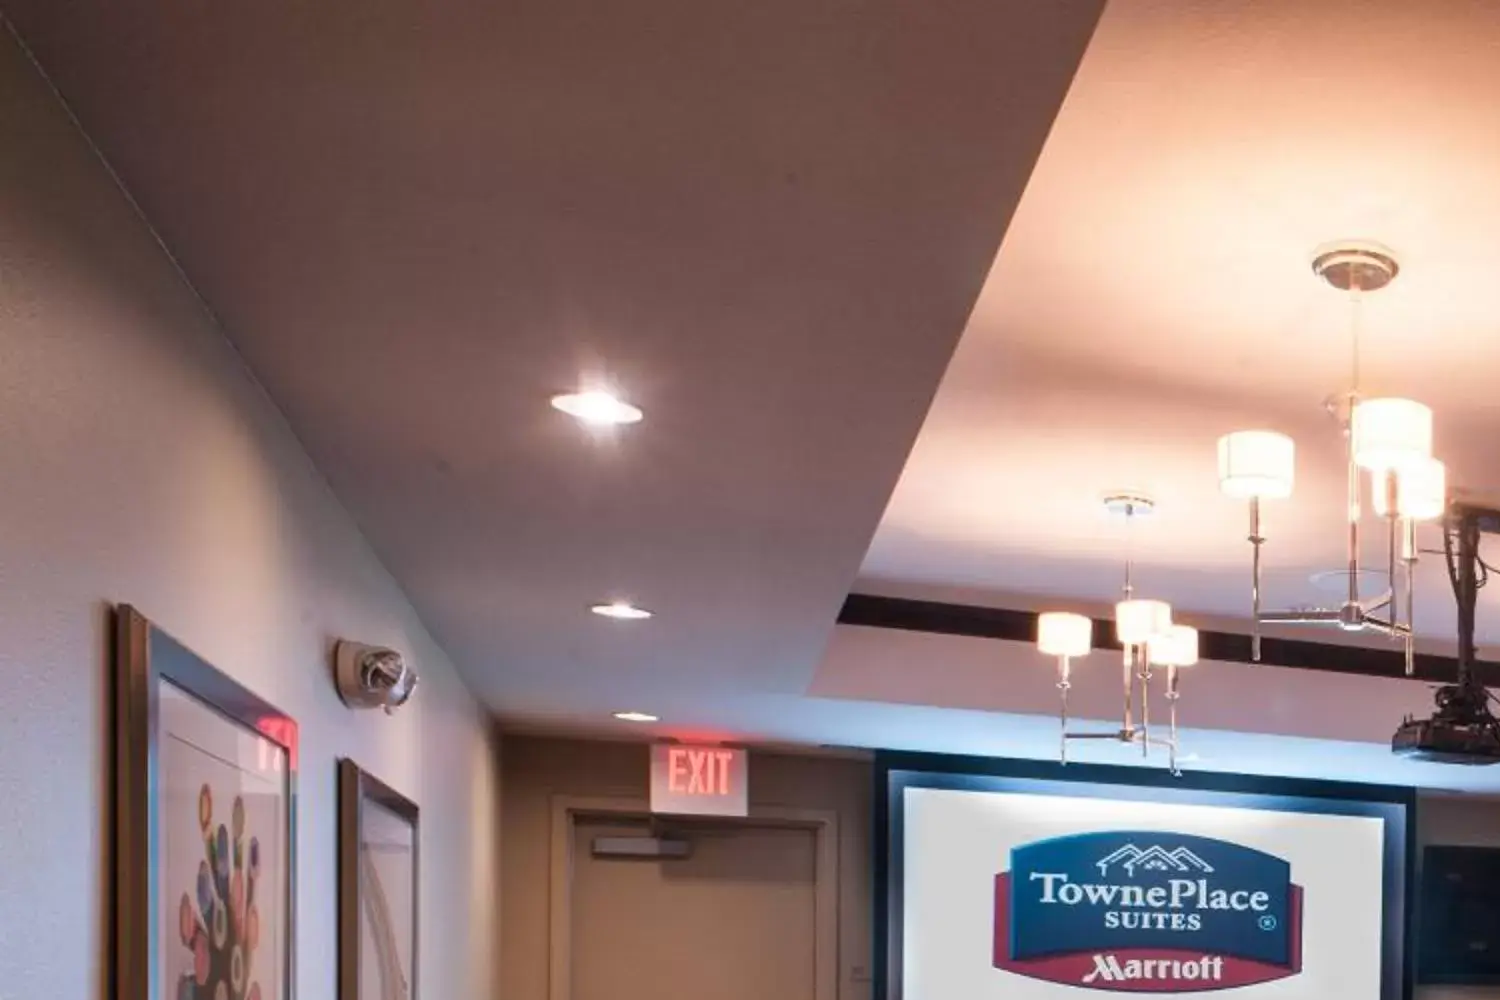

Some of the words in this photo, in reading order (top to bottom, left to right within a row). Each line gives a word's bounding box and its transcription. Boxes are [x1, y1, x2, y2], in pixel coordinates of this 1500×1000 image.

[668, 749, 733, 795] EXIT
[1029, 871, 1270, 911] TownePlace
[1104, 911, 1202, 931] SUITES
[1082, 954, 1224, 982] Marriott
